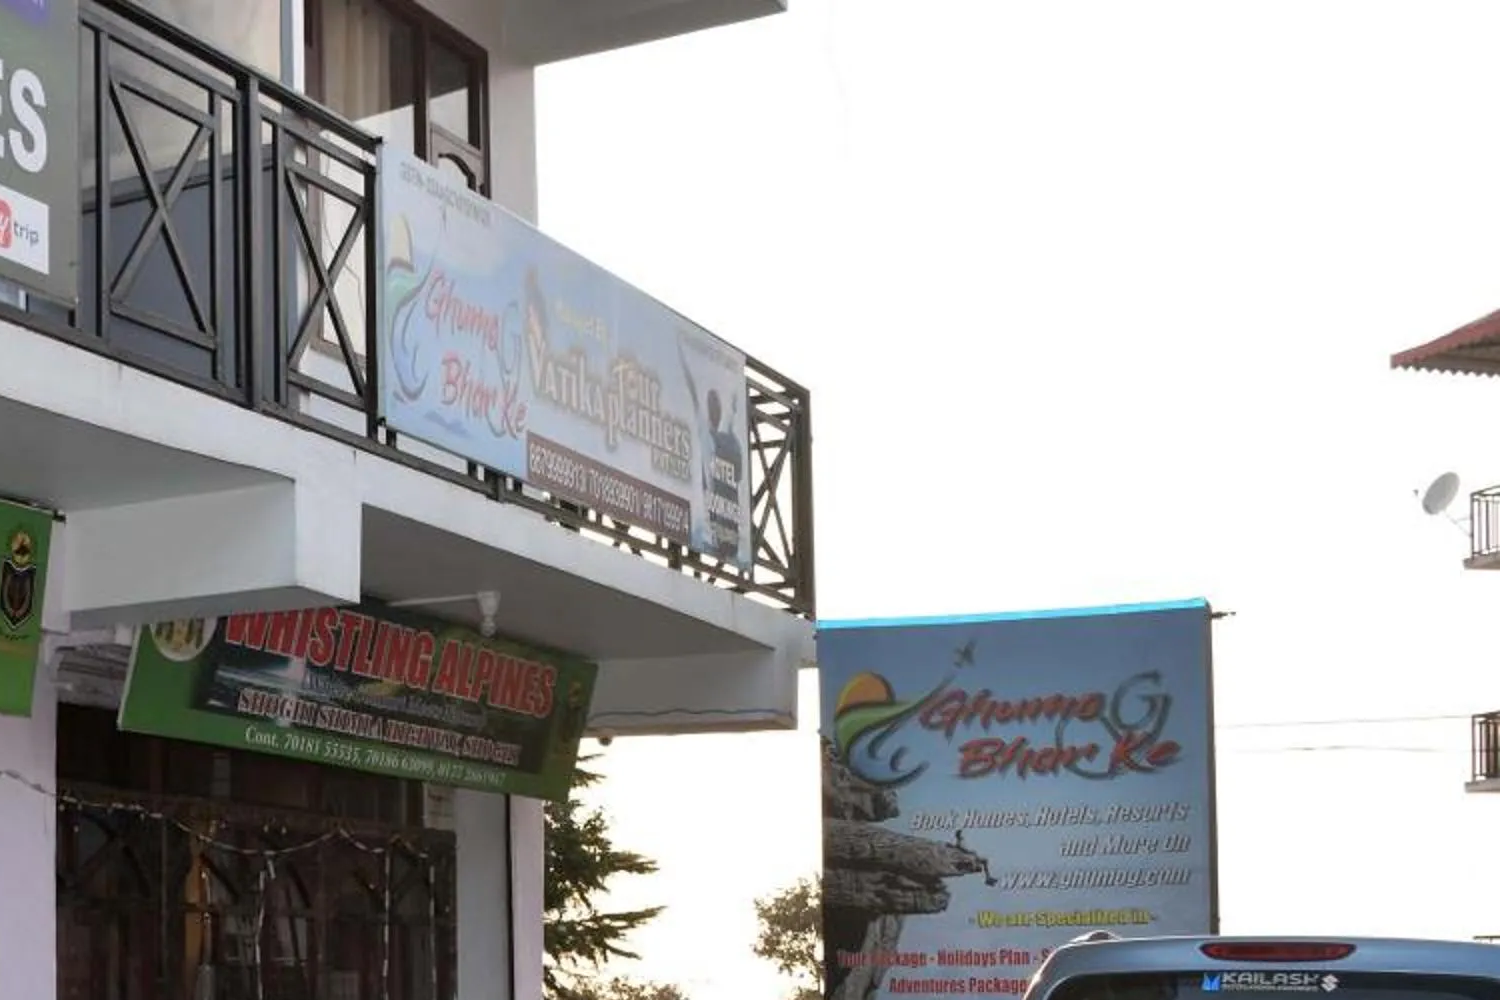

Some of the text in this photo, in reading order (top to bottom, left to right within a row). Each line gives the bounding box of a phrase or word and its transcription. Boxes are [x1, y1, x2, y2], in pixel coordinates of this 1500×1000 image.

[14, 221, 40, 247] trip
[225, 606, 435, 690] WHISTLING
[433, 639, 557, 719] ALPINES
[245, 724, 279, 748] Cont.
[284, 732, 320, 753] 70181
[937, 949, 997, 968] Holidays
[1000, 949, 1030, 966] Plan
[889, 977, 966, 993] Adventures
[1221, 971, 1321, 985] KAILASH
